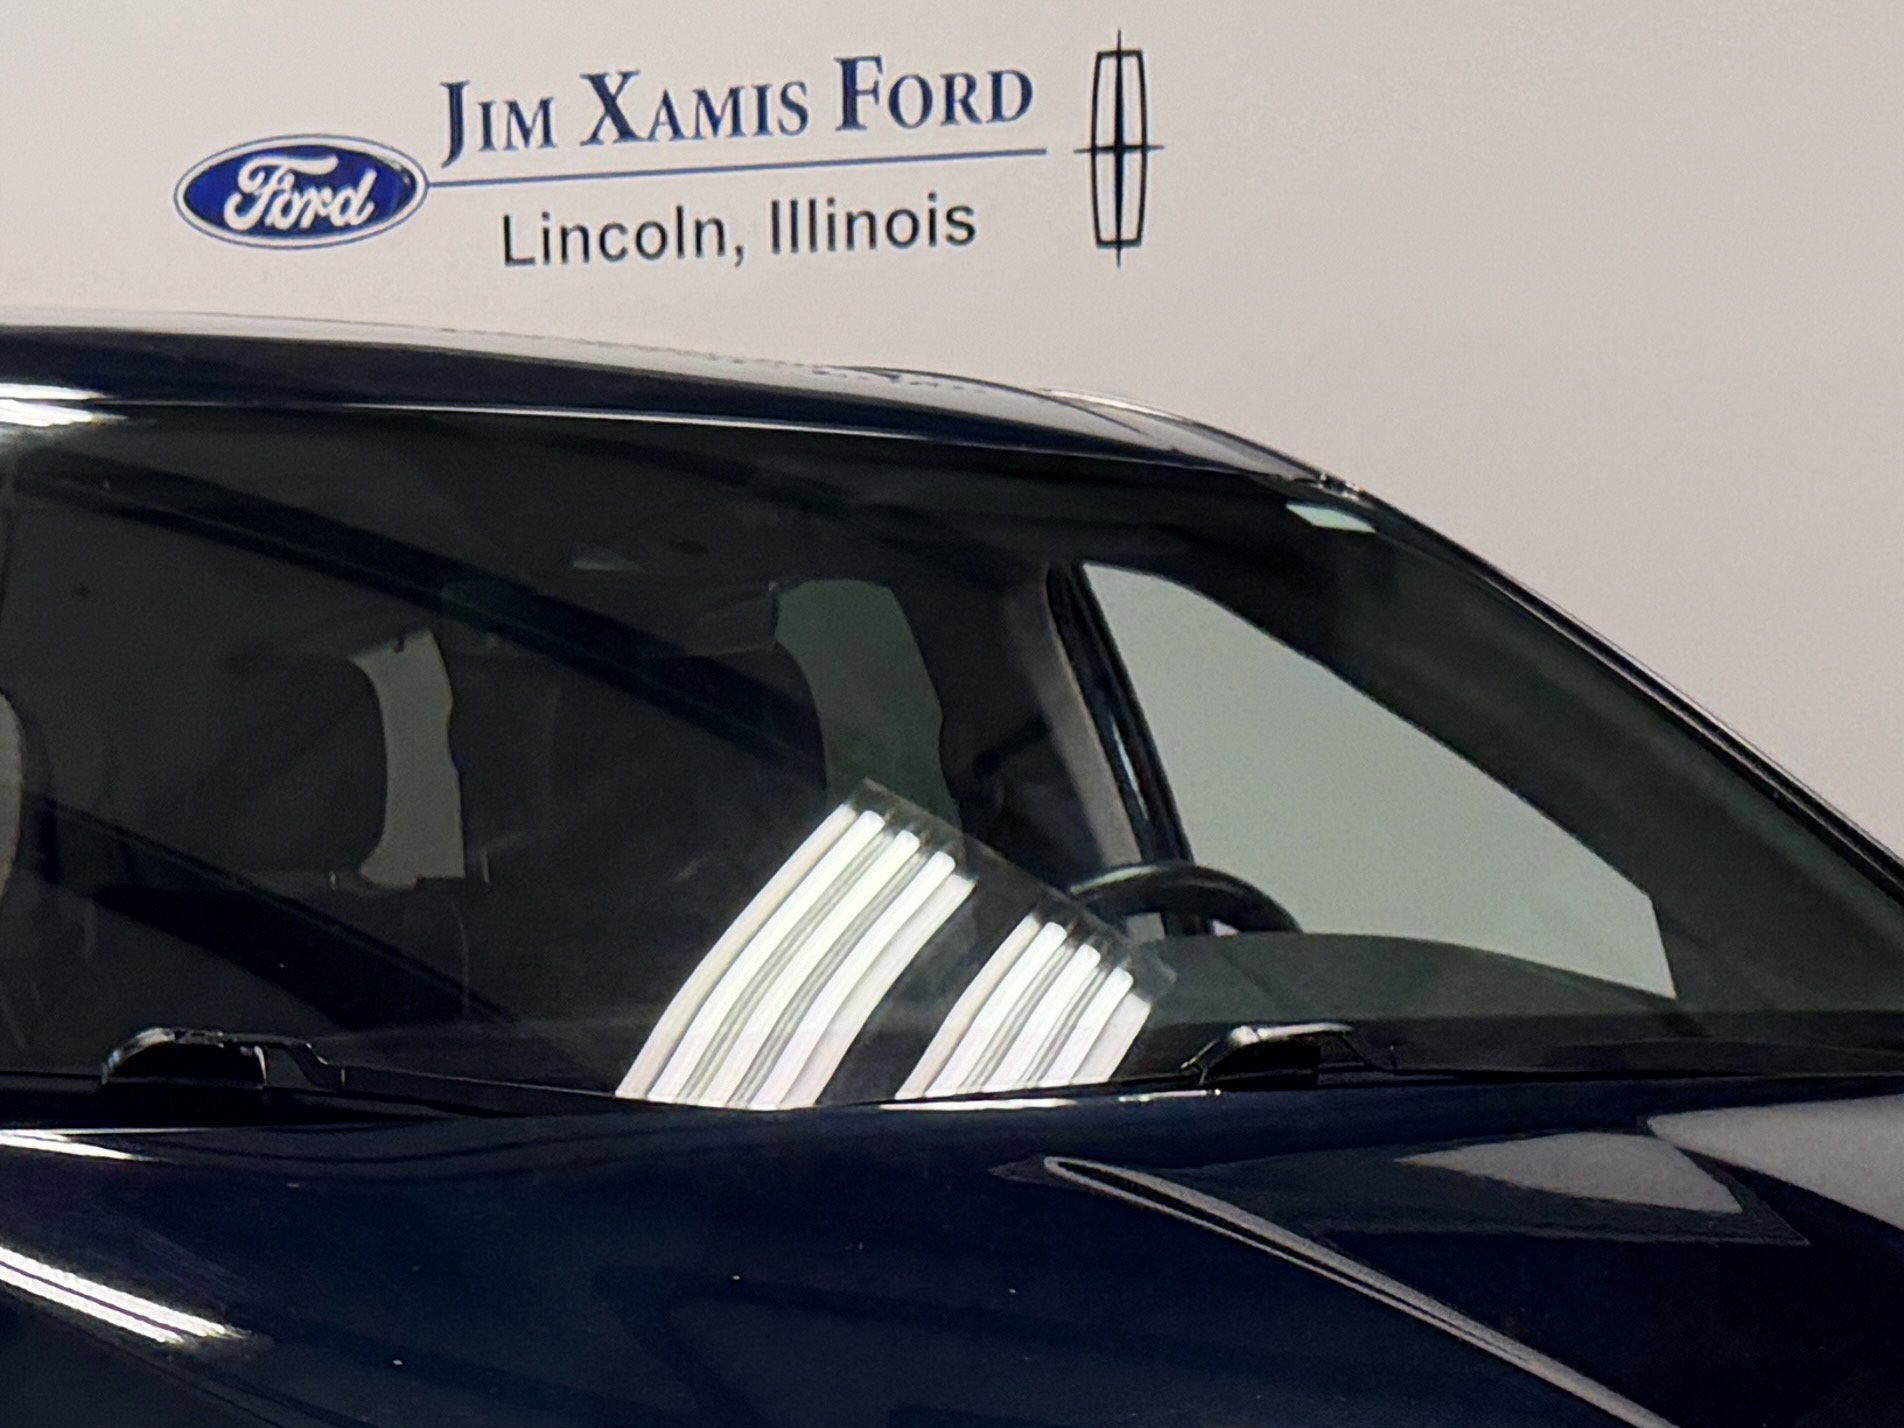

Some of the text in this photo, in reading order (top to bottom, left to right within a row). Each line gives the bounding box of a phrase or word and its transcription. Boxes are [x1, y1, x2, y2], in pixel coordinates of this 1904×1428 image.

[223, 153, 378, 231] Ford
[502, 191, 977, 268] Lincoln, Illinois
